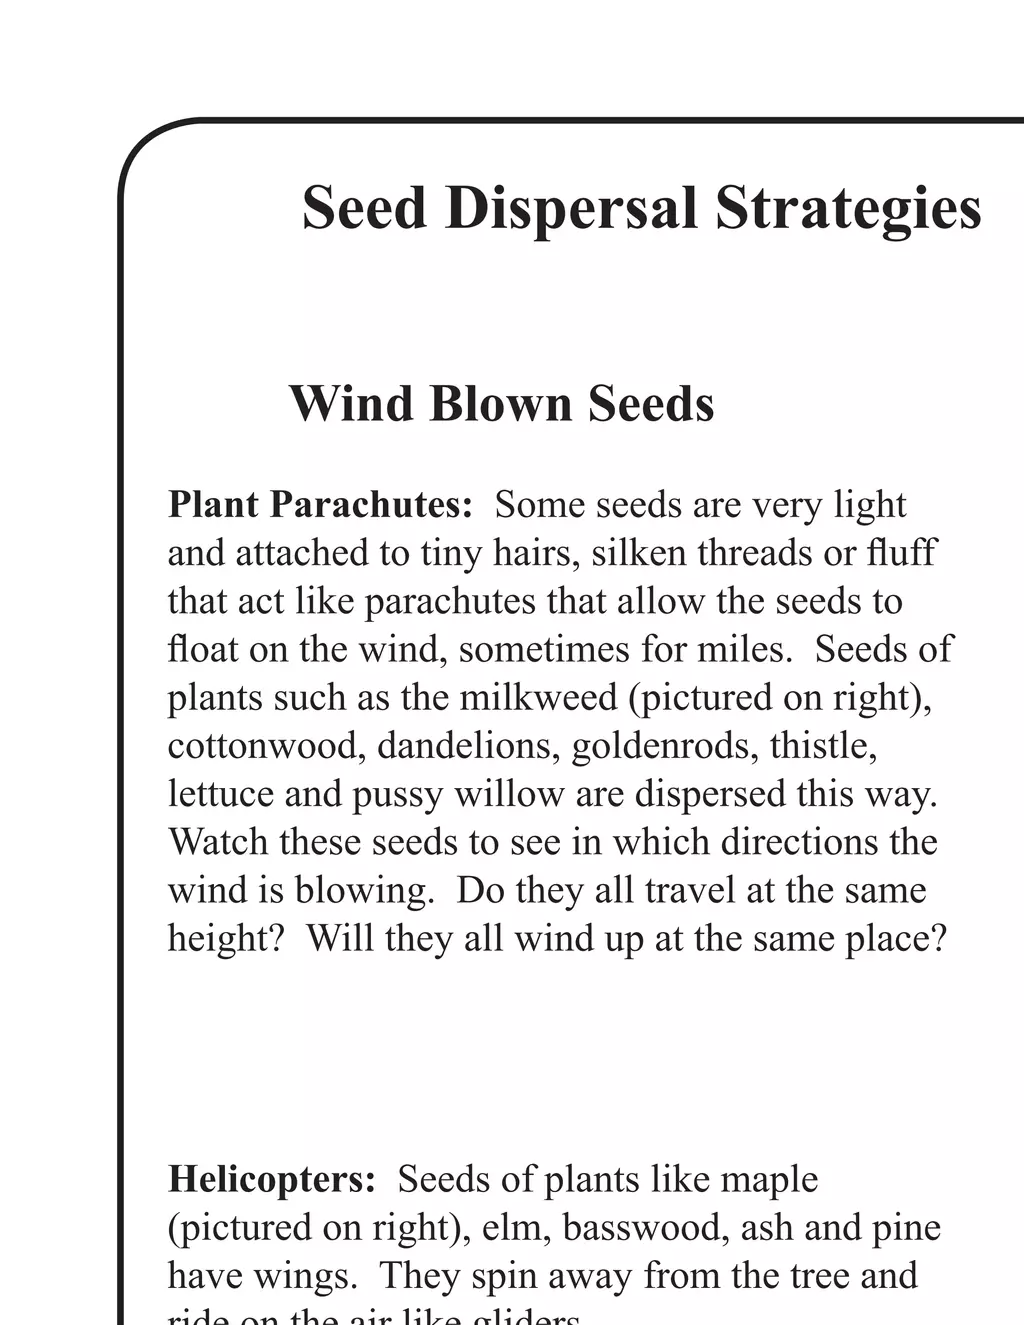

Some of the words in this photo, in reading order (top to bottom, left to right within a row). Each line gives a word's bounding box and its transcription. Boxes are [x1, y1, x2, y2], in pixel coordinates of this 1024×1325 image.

[303, 184, 428, 230] Seed
[444, 184, 699, 243] Dispersal
[717, 184, 982, 243] Strategies
[287, 383, 414, 422] Wind
[428, 384, 573, 422] Blown
[589, 383, 714, 422] Seeds
[168, 489, 260, 518] Plant
[269, 489, 472, 519] Parachutes:
[496, 489, 585, 519] Some
[596, 488, 682, 519] seeds
[693, 497, 742, 519] are
[751, 497, 824, 527] very
[834, 488, 908, 527] light
[168, 536, 226, 567] and
[236, 536, 370, 567] attached
[379, 540, 410, 567] to
[420, 536, 484, 575] tiny
[493, 536, 580, 573] hairs,
[592, 536, 688, 567] silken
[697, 536, 813, 567] threads
[823, 546, 858, 567] or
[866, 536, 940, 567] fluff
[167, 584, 228, 615] that
[238, 589, 285, 615] act
[295, 584, 355, 615] like
[364, 584, 536, 623] parachutes
[546, 584, 608, 615] that
[617, 584, 706, 615] allow
[716, 584, 765, 615] the
[776, 584, 862, 615] seeds
[872, 589, 903, 615] to
[167, 633, 240, 663] float
[249, 642, 289, 663] on
[299, 633, 348, 663] the
[358, 633, 447, 669] wind,
[459, 633, 630, 663] sometimes
[641, 633, 688, 663] for
[697, 633, 792, 663] miles.
[816, 633, 908, 663] Seeds
[918, 633, 957, 663] of
[167, 681, 263, 719] plants
[274, 681, 347, 711] such
[357, 690, 390, 711] as
[400, 681, 449, 711] the
[459, 681, 619, 711] milkweed
[629, 681, 774, 719] (pictured
[783, 690, 824, 711] on
[833, 681, 931, 719] right),
[168, 729, 366, 765] cottonwood,
[377, 729, 560, 765] dandelions,
[571, 729, 759, 768] goldenrods,
[769, 729, 877, 765] thistle,
[168, 777, 274, 808] lettuce
[285, 777, 343, 808] and
[352, 786, 445, 816] pussy
[453, 777, 566, 808] willow
[576, 786, 624, 808] are
[635, 777, 787, 816] dispersed
[796, 777, 854, 808] this
[864, 786, 937, 816] way.
[167, 825, 269, 856] Watch
[279, 825, 361, 856] these
[372, 825, 458, 856] seeds
[468, 830, 499, 856] to
[511, 835, 561, 856] see
[572, 825, 603, 855] in
[612, 825, 711, 856] which
[721, 825, 879, 856] directions
[889, 825, 938, 856] the
[167, 874, 249, 904] wind
[258, 873, 284, 904] is
[294, 873, 434, 912] blowing.
[456, 875, 505, 904] Do
[515, 873, 585, 912] they
[595, 874, 634, 904] all
[644, 874, 736, 904] travel
[747, 878, 776, 904] at
[785, 874, 834, 904] the
[845, 883, 927, 904] same
[167, 922, 285, 960] height?
[305, 922, 375, 952] Will
[384, 922, 454, 960] they
[464, 922, 504, 952] all
[514, 922, 595, 952] wind
[604, 931, 644, 960] up
[655, 926, 685, 952] at
[693, 922, 743, 952] the
[754, 931, 835, 952] same
[845, 922, 947, 960] place?
[167, 1163, 375, 1201] Helicopters:
[398, 1163, 490, 1193] Seeds
[501, 1163, 539, 1193] of
[543, 1163, 640, 1201] plants
[651, 1163, 710, 1193] like
[720, 1163, 819, 1201] maple
[168, 1211, 313, 1249] (pictured
[323, 1220, 363, 1241] on
[372, 1211, 471, 1249] right),
[482, 1211, 551, 1247] elm,
[561, 1211, 730, 1247] basswood,
[741, 1211, 795, 1241] ash
[805, 1211, 863, 1241] and
[871, 1211, 941, 1249] pine
[167, 1259, 243, 1290] have
[253, 1259, 357, 1298] wings.
[379, 1259, 462, 1298] They
[472, 1259, 539, 1298] spin
[548, 1268, 633, 1298] away
[643, 1259, 721, 1290] from
[731, 1259, 780, 1290] the
[790, 1263, 850, 1290] tree
[861, 1259, 919, 1290] and
